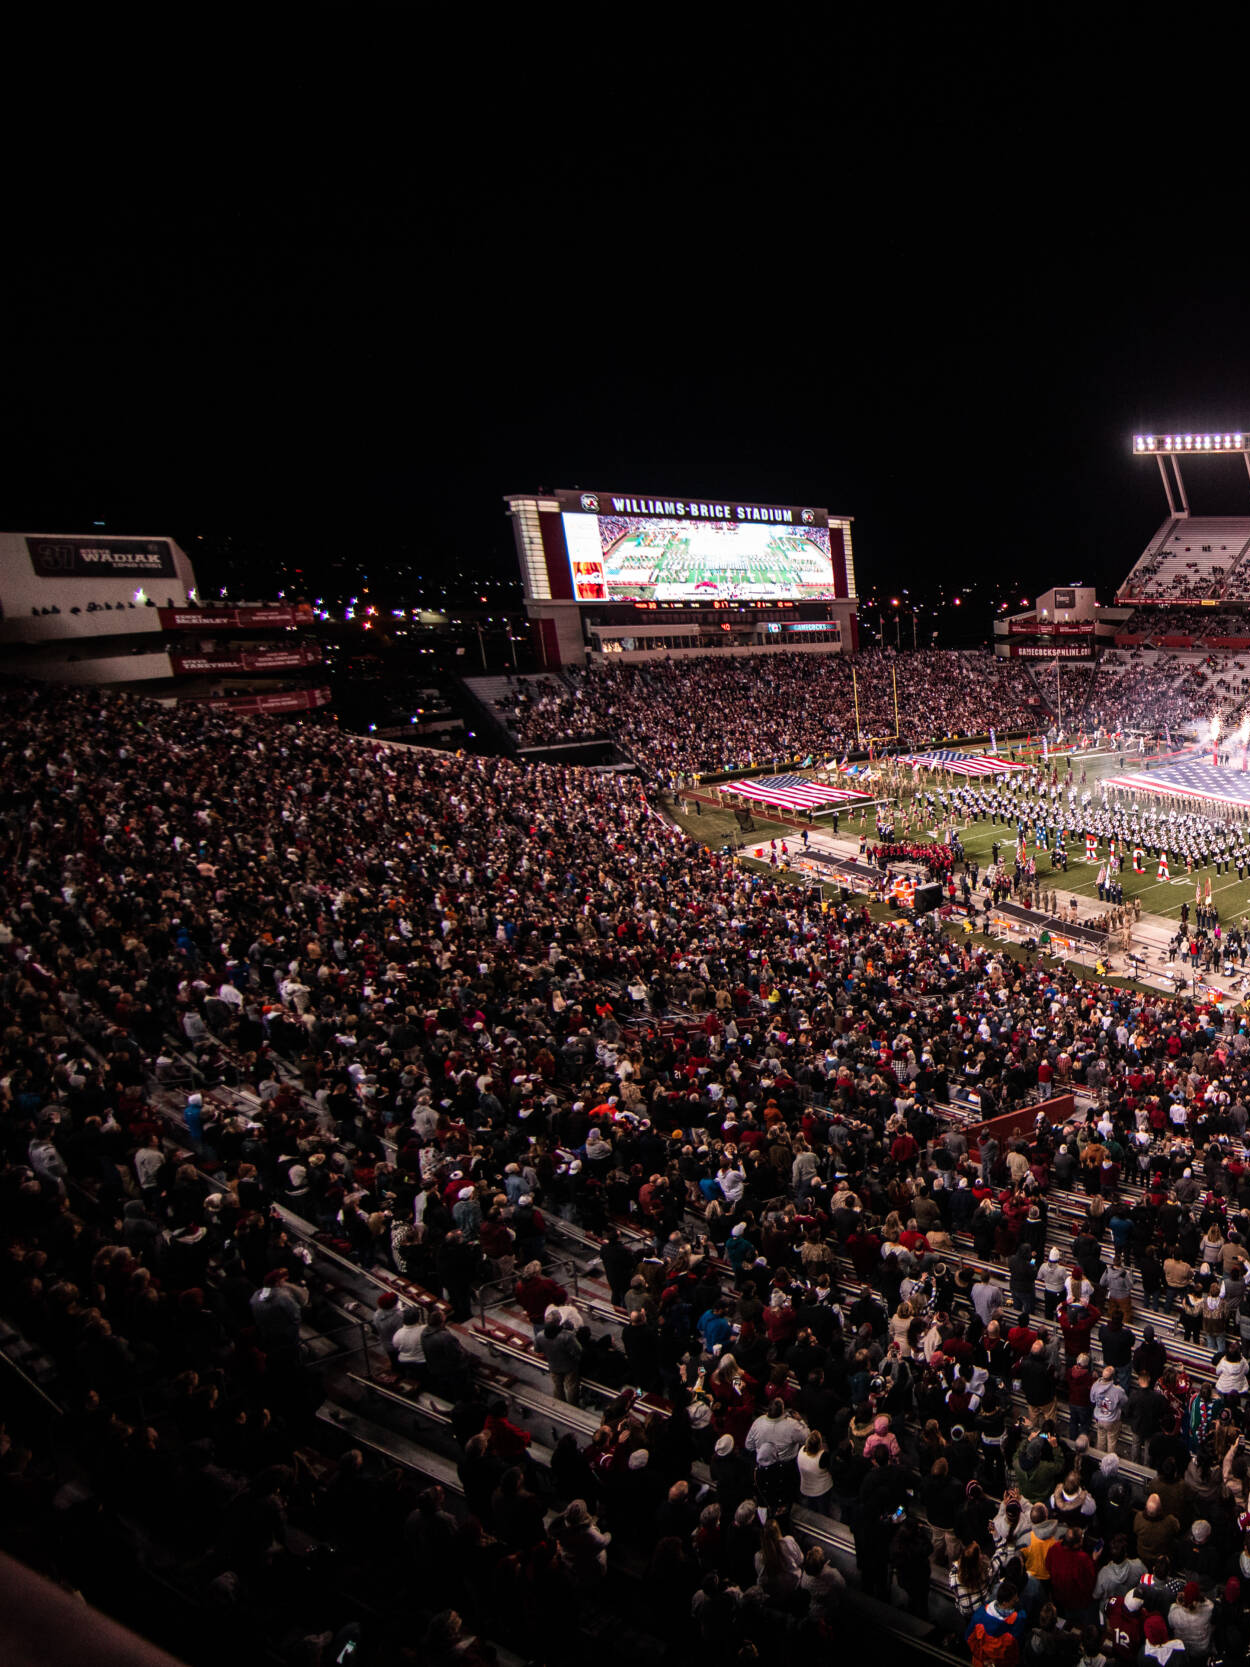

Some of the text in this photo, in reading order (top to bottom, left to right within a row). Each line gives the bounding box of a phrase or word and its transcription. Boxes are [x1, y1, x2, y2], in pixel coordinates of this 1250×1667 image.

[612, 498, 793, 522] WILLIAMS-BRICE STADIUM
[80, 553, 162, 563] WADIAK
